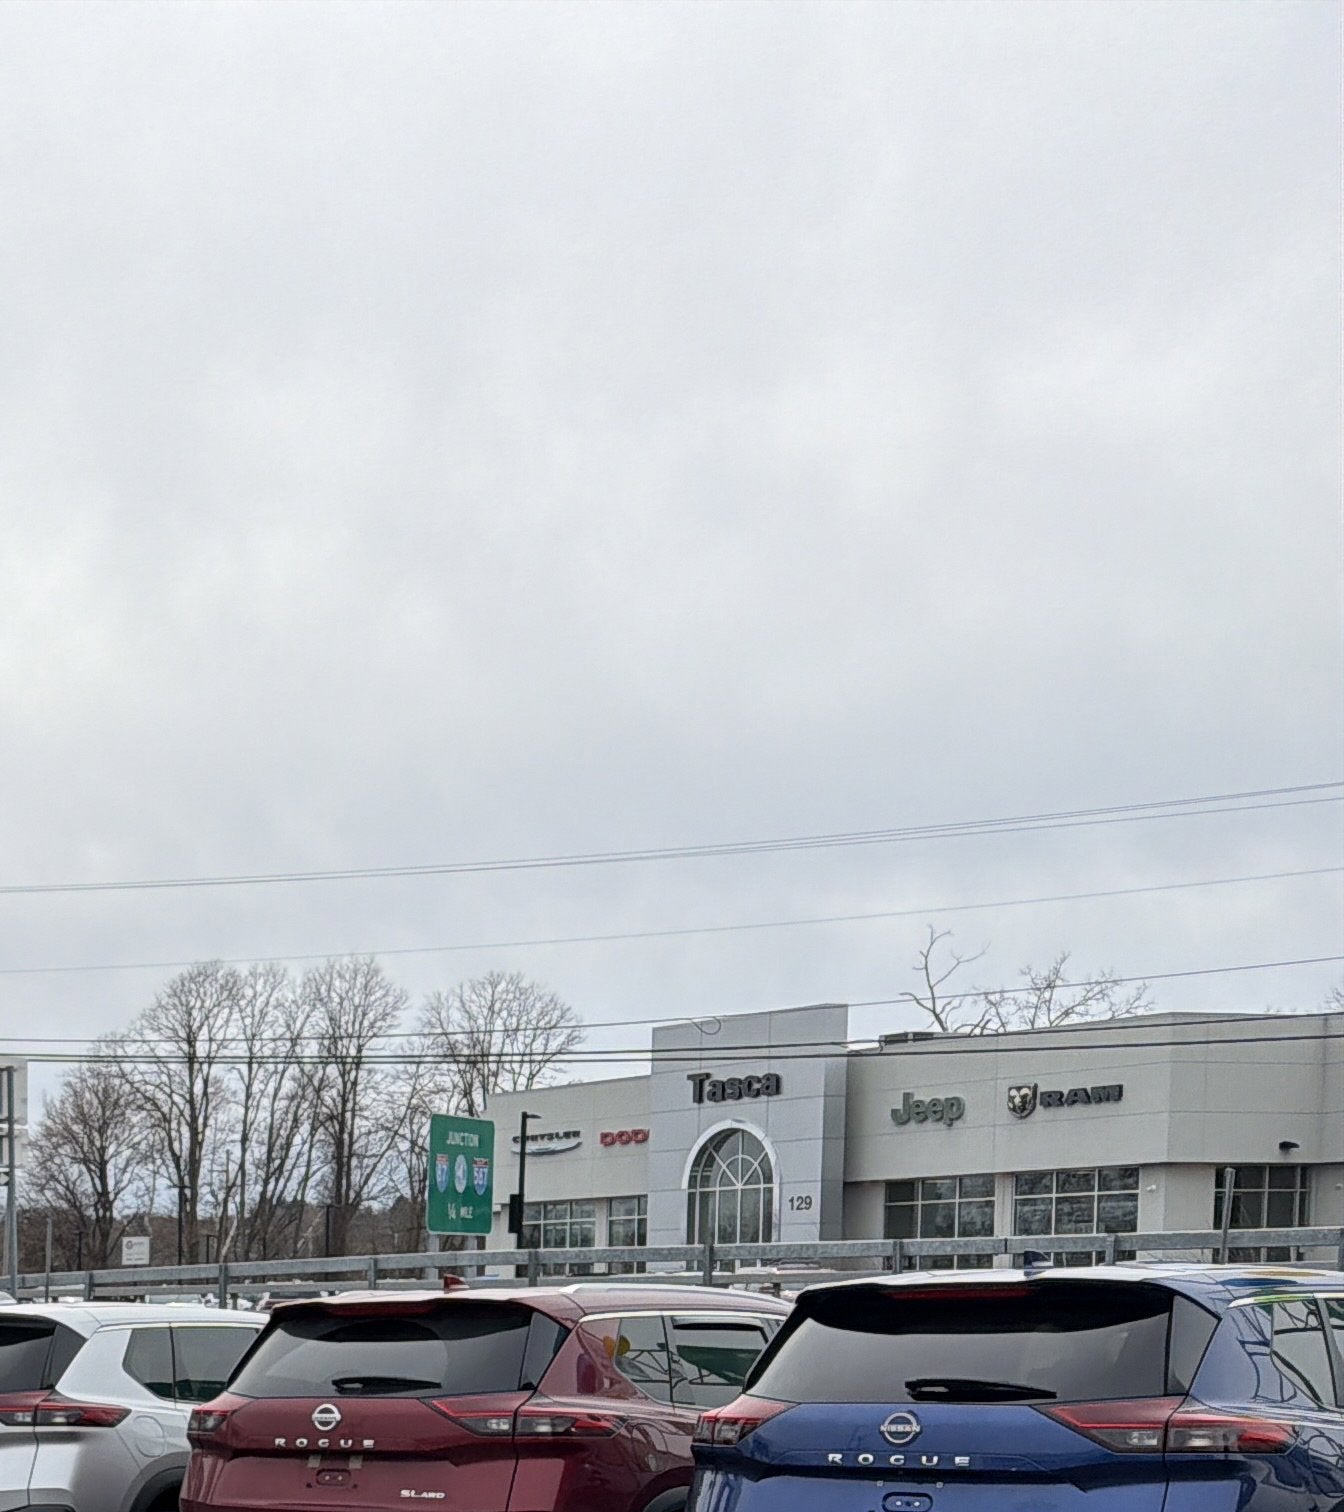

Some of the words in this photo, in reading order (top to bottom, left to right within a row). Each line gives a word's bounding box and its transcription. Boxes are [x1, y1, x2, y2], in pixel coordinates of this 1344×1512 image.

[686, 1072, 782, 1104] Tasca
[1039, 1083, 1123, 1107] RAM
[890, 1091, 965, 1127] Jeep
[446, 1131, 479, 1148] JUNCTION
[600, 1128, 650, 1147] DOD
[788, 1195, 813, 1211] 129
[274, 1437, 375, 1449] ROGUE
[827, 1453, 971, 1467] ROGUE
